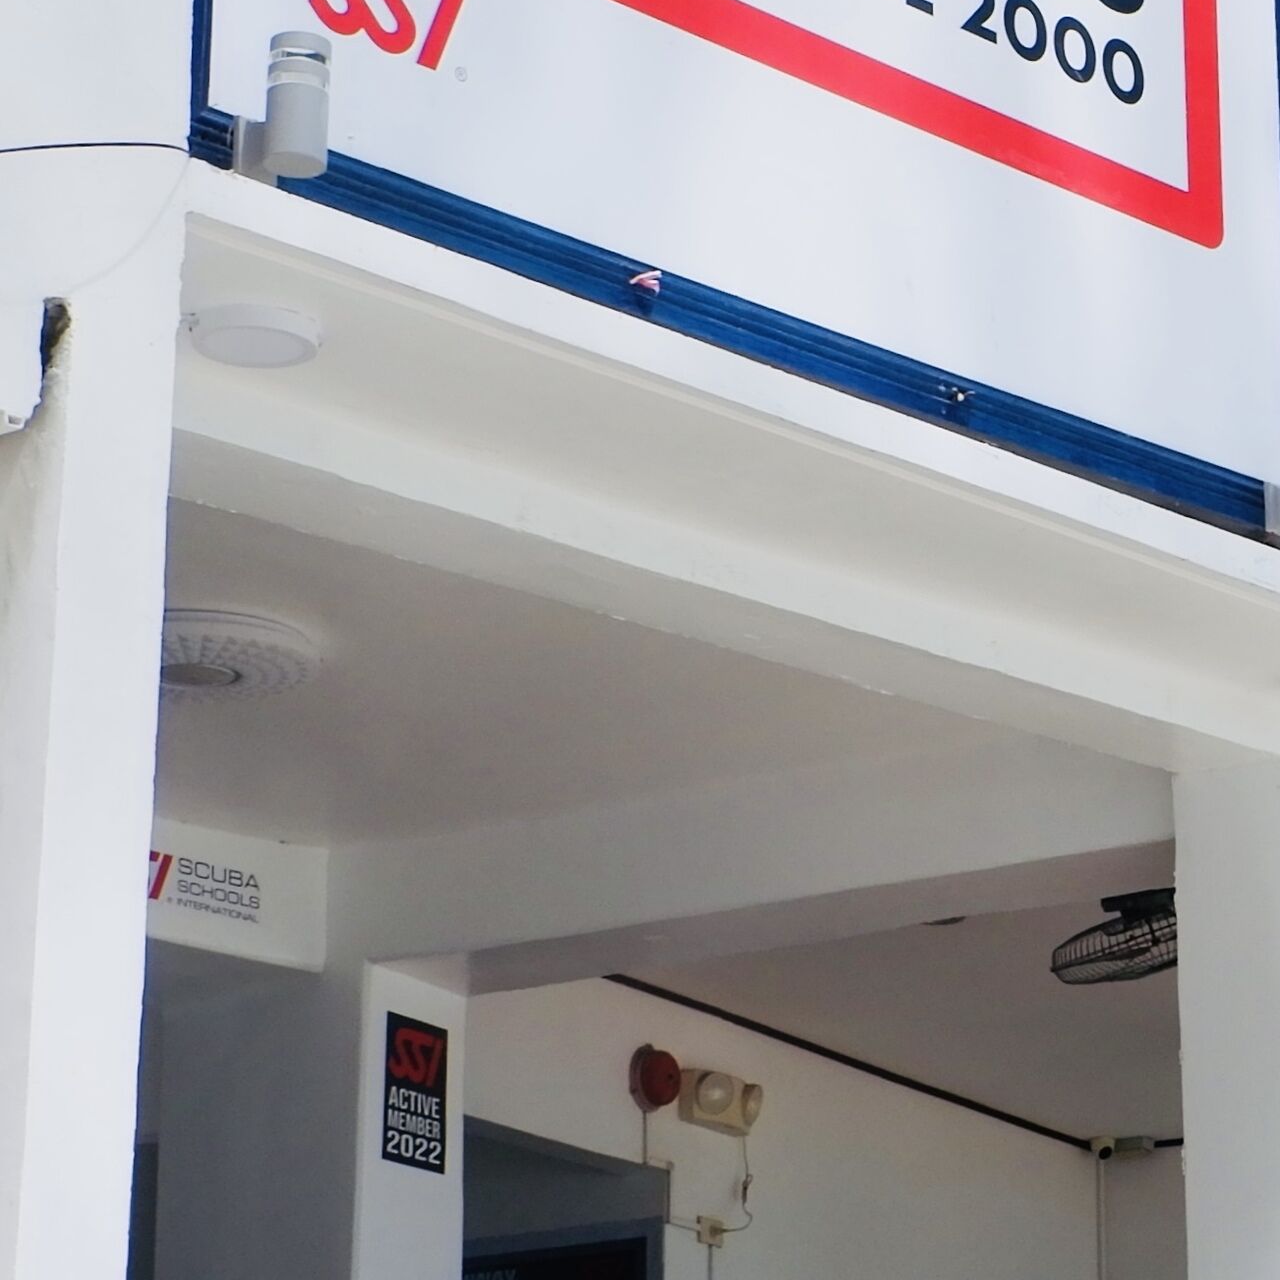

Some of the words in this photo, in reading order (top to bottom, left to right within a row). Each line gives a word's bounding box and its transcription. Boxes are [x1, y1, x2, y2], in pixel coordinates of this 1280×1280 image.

[178, 857, 259, 891] SCUBA
[177, 880, 260, 910] SCHOOLS
[177, 898, 259, 924] INTERNATIONAL
[388, 1027, 443, 1087] SSI
[388, 1085, 440, 1119] ACTIVE
[387, 1108, 441, 1139] MEMBER
[386, 1129, 442, 1164] 2022
